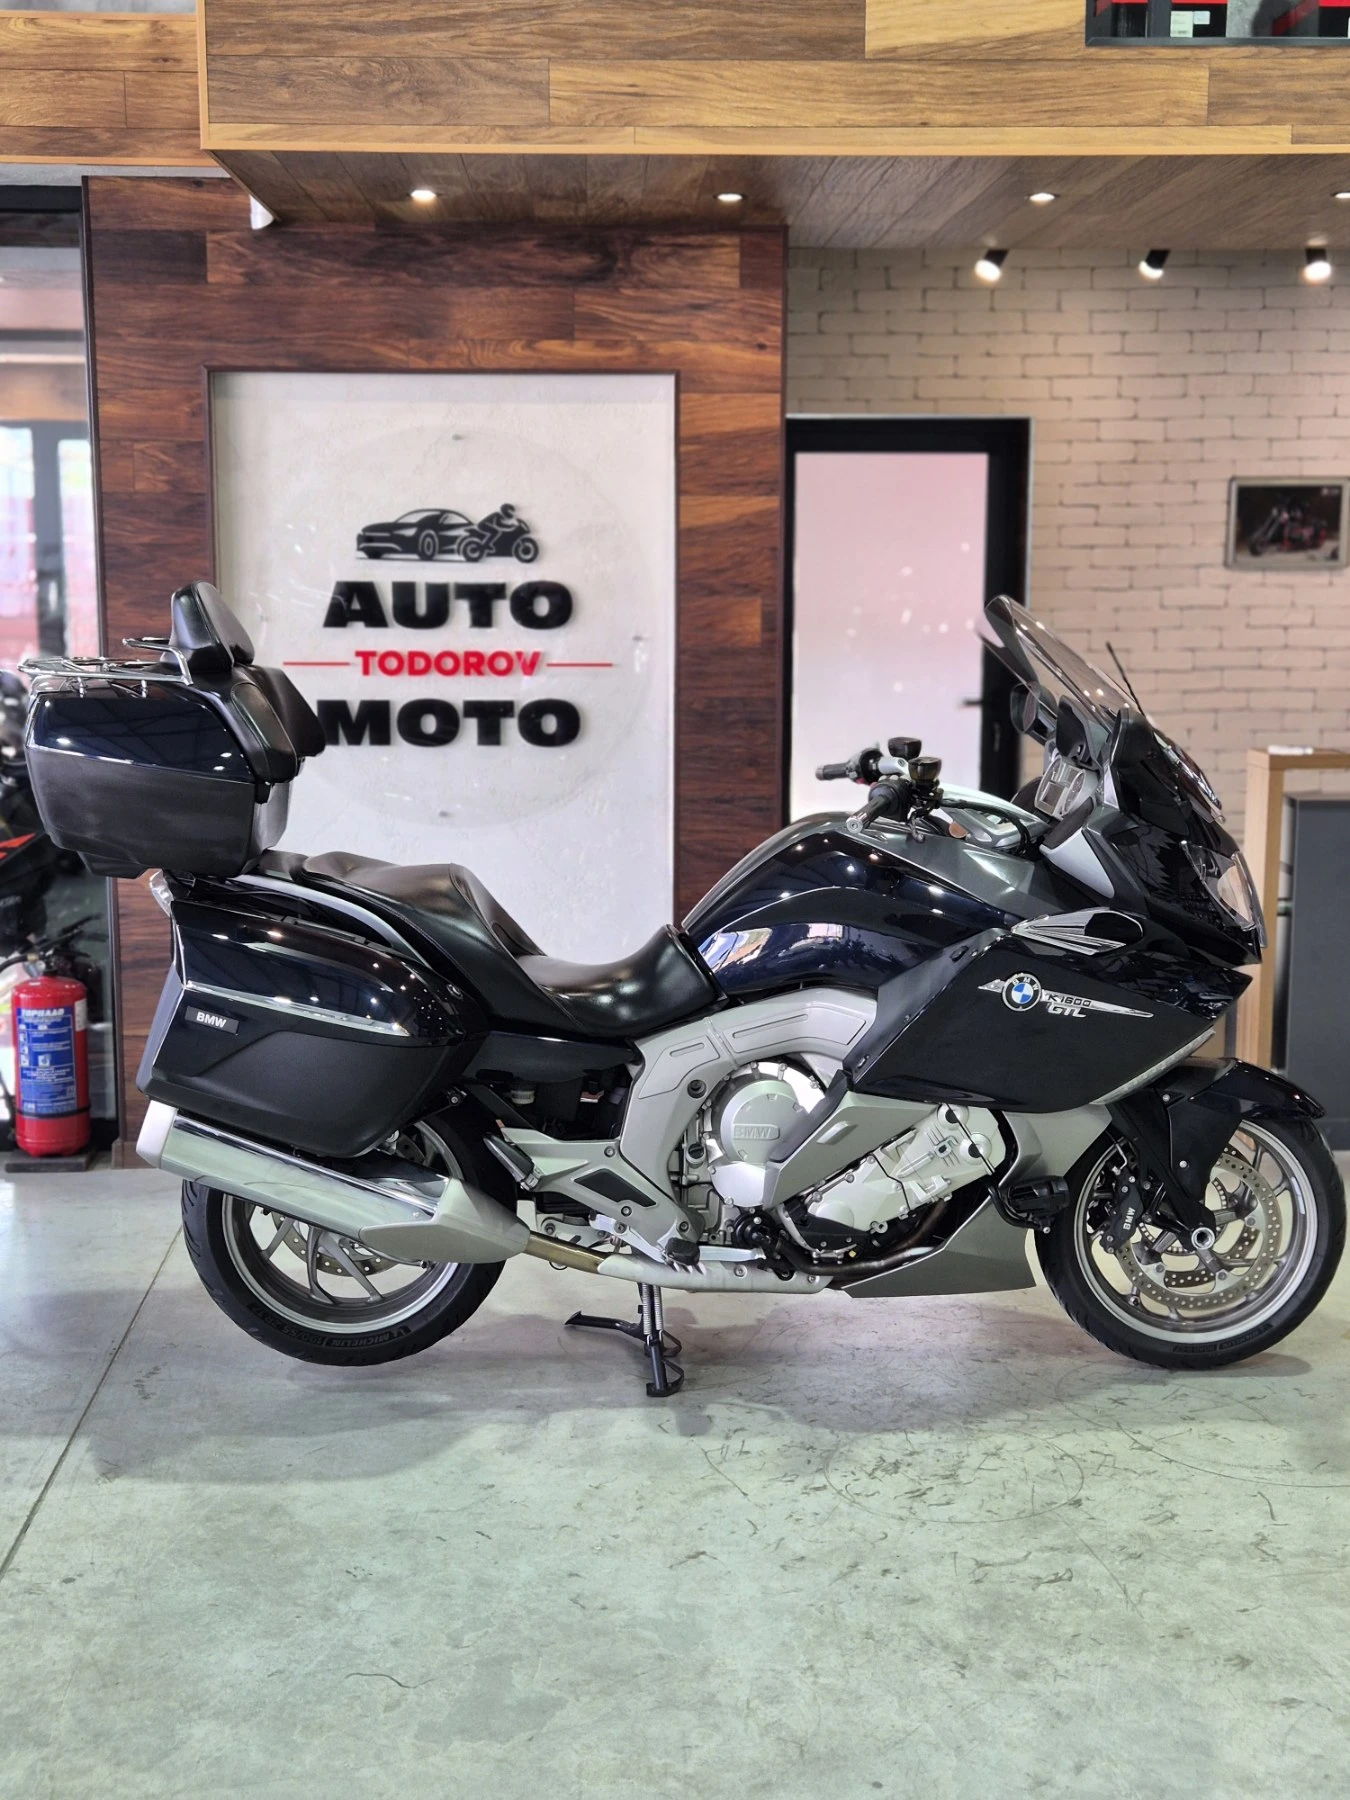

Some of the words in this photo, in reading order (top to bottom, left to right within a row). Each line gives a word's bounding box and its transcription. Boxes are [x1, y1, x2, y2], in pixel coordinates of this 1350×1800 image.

[323, 580, 574, 630] AUTO
[355, 650, 542, 676] TODOROV
[316, 698, 581, 747] MOTO
[1012, 977, 1039, 991] BMW
[1060, 995, 1092, 1007] 1600
[1047, 1002, 1086, 1018] GTL
[196, 1011, 227, 1028] BMW
[735, 1126, 771, 1139] BMW
[1123, 1207, 1136, 1230] BMW
[332, 1334, 390, 1347] MICHELIN
